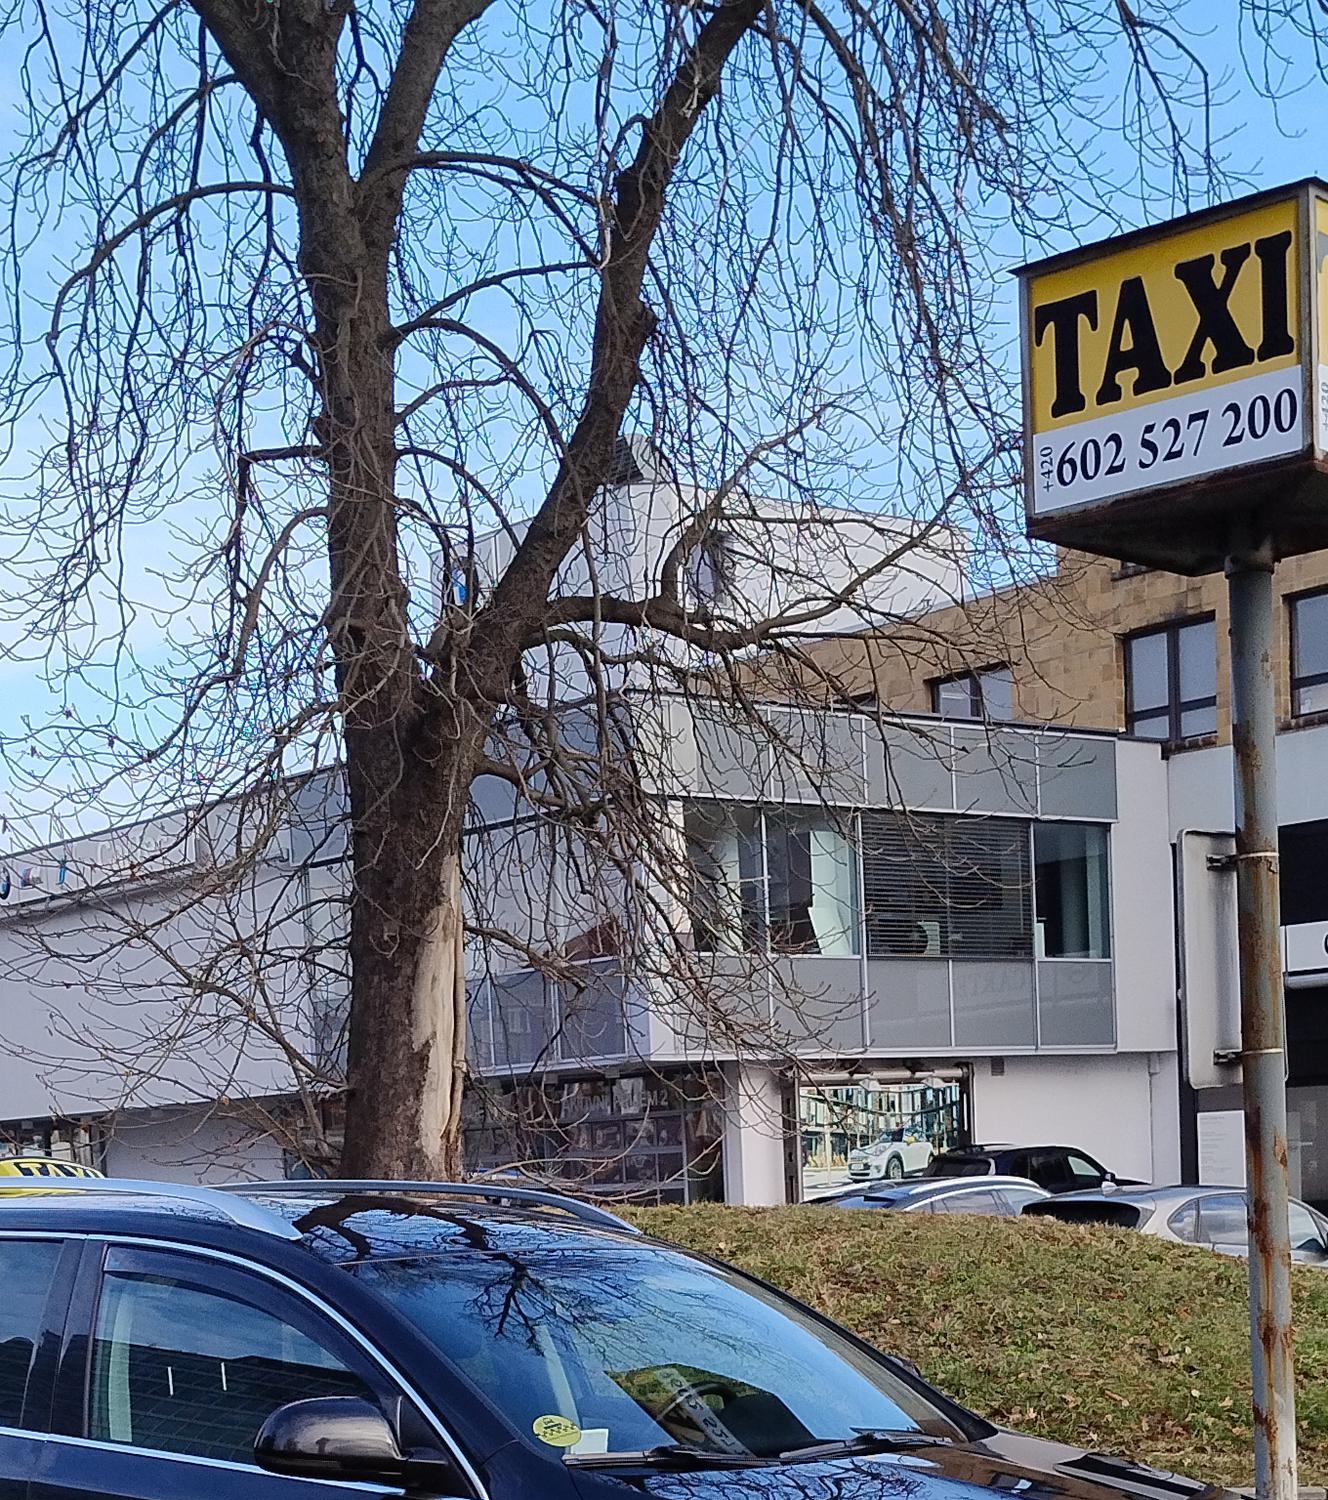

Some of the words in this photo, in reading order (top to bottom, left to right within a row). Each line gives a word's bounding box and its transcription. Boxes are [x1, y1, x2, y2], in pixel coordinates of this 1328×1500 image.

[1034, 230, 1293, 420] TAXI
[1040, 446, 1054, 493] +420
[1056, 433, 1127, 487] 602
[1138, 409, 1210, 469] 527
[1221, 388, 1298, 447] 200
